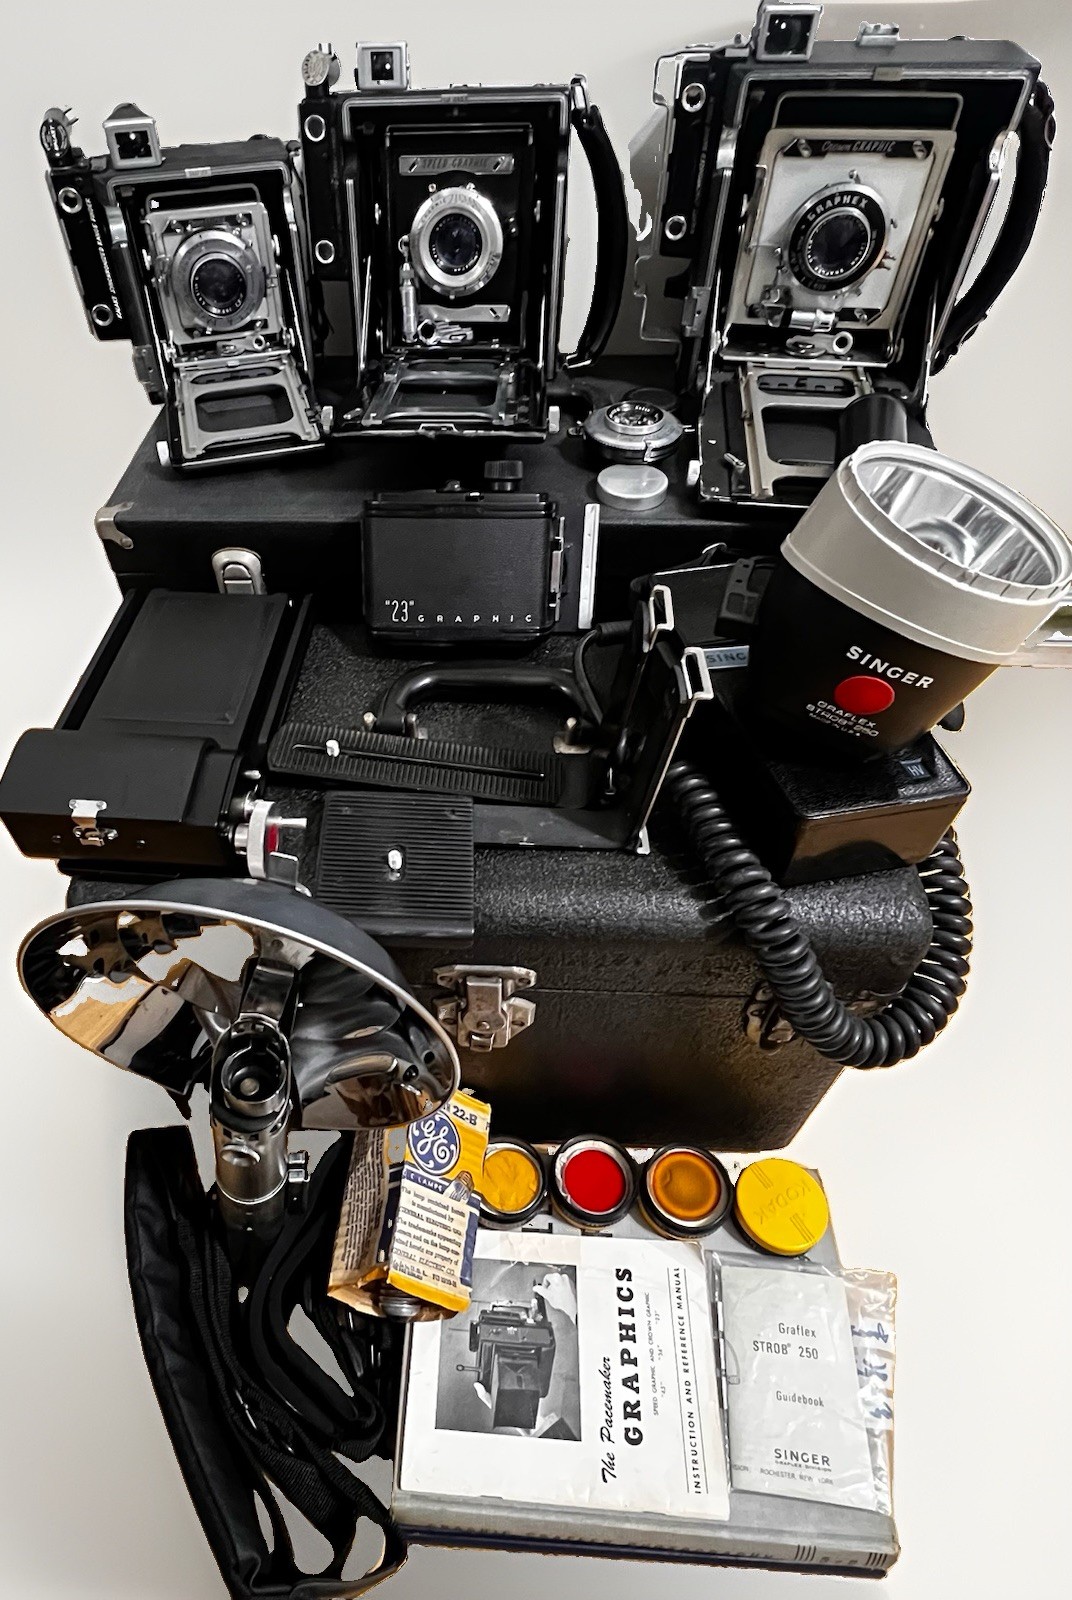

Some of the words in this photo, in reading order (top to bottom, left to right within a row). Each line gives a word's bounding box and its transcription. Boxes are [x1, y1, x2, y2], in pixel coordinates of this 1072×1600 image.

[852, 140, 896, 152] GRAPHIC
[423, 158, 448, 169] SPEED
[806, 194, 869, 222] GRAPHEX
[417, 614, 532, 623] GRAPHIC
[845, 645, 934, 689] SINGER
[817, 700, 877, 729] GRAFLEX
[906, 765, 925, 777] HV
[452, 1105, 478, 1126] 22-B
[417, 1176, 443, 1192] LAMPS
[753, 1181, 811, 1225] KODAK
[673, 1267, 684, 1310] MANUAL
[644, 1291, 652, 1318] GRAPHIC
[778, 1322, 817, 1338] Graflex
[614, 1267, 644, 1446] GRAPHICS
[677, 1315, 690, 1374] REFERENCE
[798, 1345, 819, 1360] 250
[650, 1365, 658, 1394] GRAPHIC
[684, 1380, 693, 1404] AND
[598, 1356, 616, 1444] Pacemaker
[775, 1390, 825, 1408] Guidebook
[686, 1411, 702, 1495] INSTRUCTION
[773, 1447, 831, 1467] SINGER
[600, 1452, 618, 1483] The
